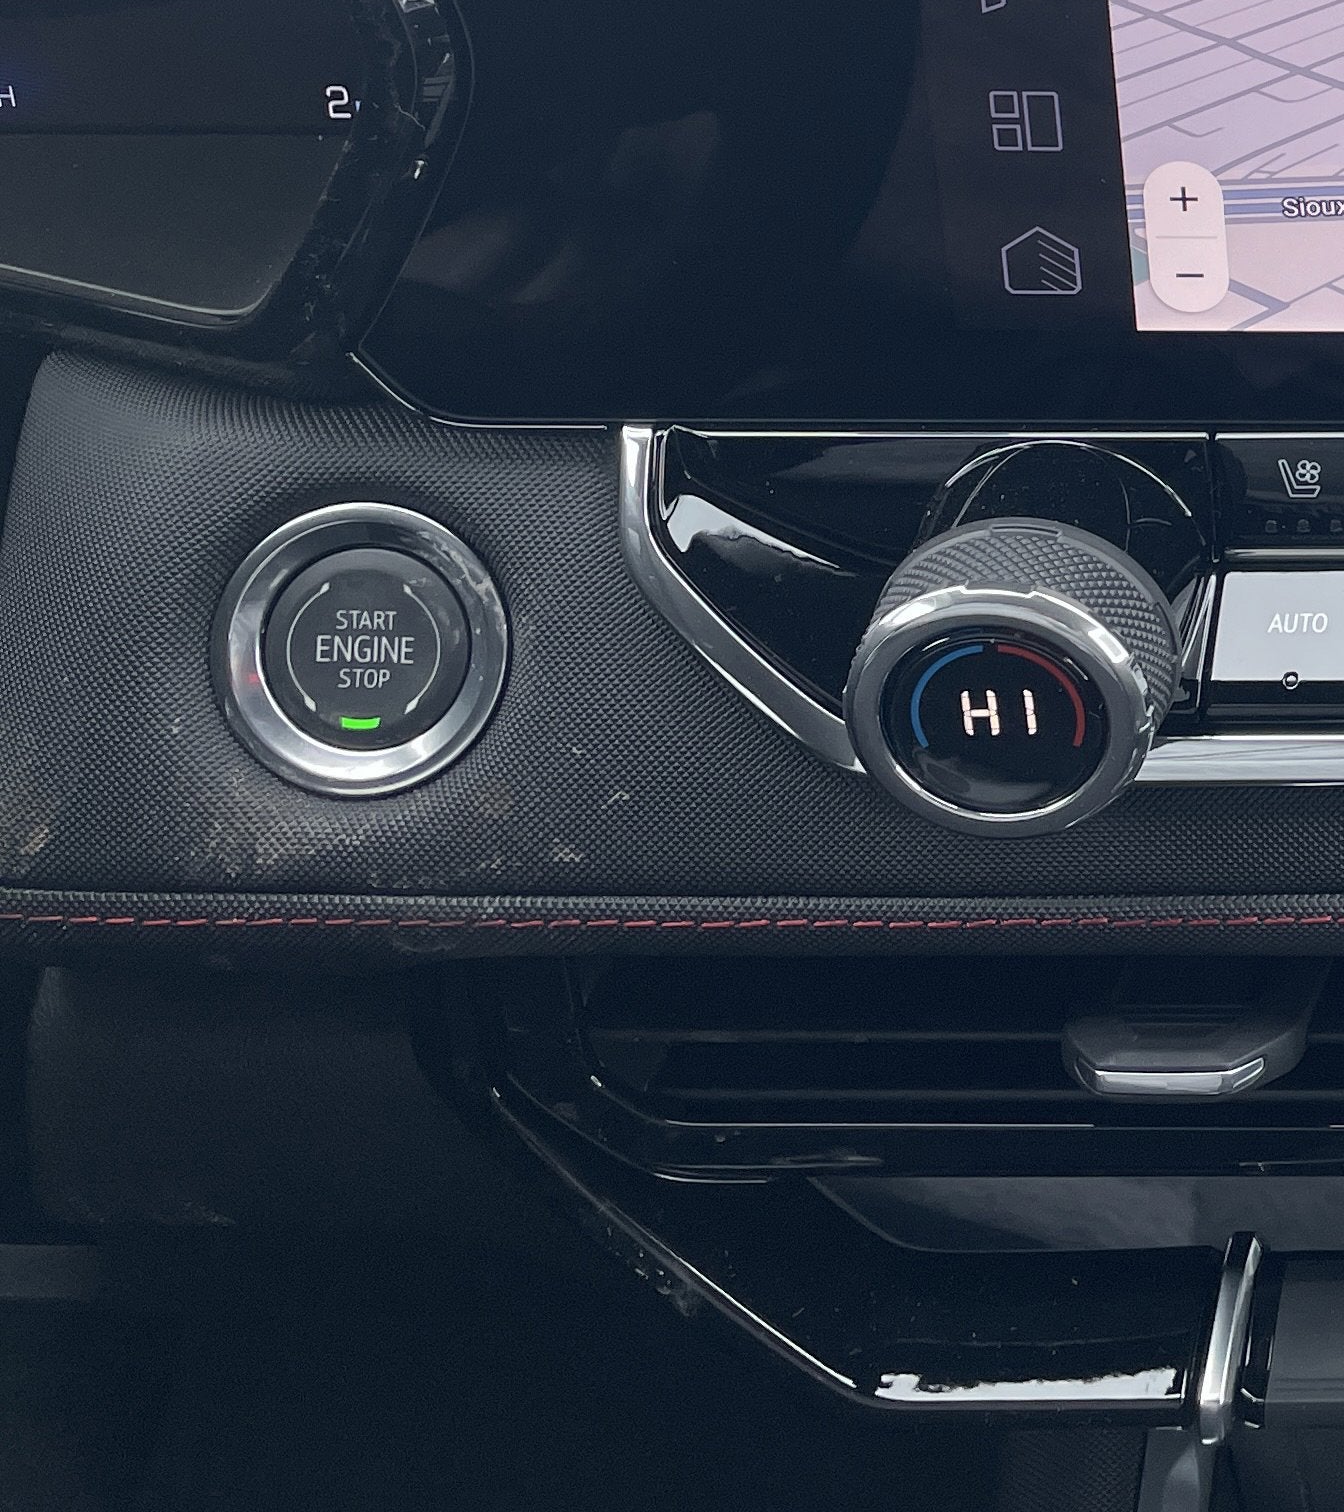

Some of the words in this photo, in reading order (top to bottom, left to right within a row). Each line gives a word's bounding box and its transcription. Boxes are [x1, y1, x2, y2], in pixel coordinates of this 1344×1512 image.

[336, 610, 397, 631] START
[1267, 613, 1328, 634] AUTO
[315, 634, 415, 664] ENGINE
[337, 668, 391, 689] STOP
[961, 689, 1037, 736] HI
